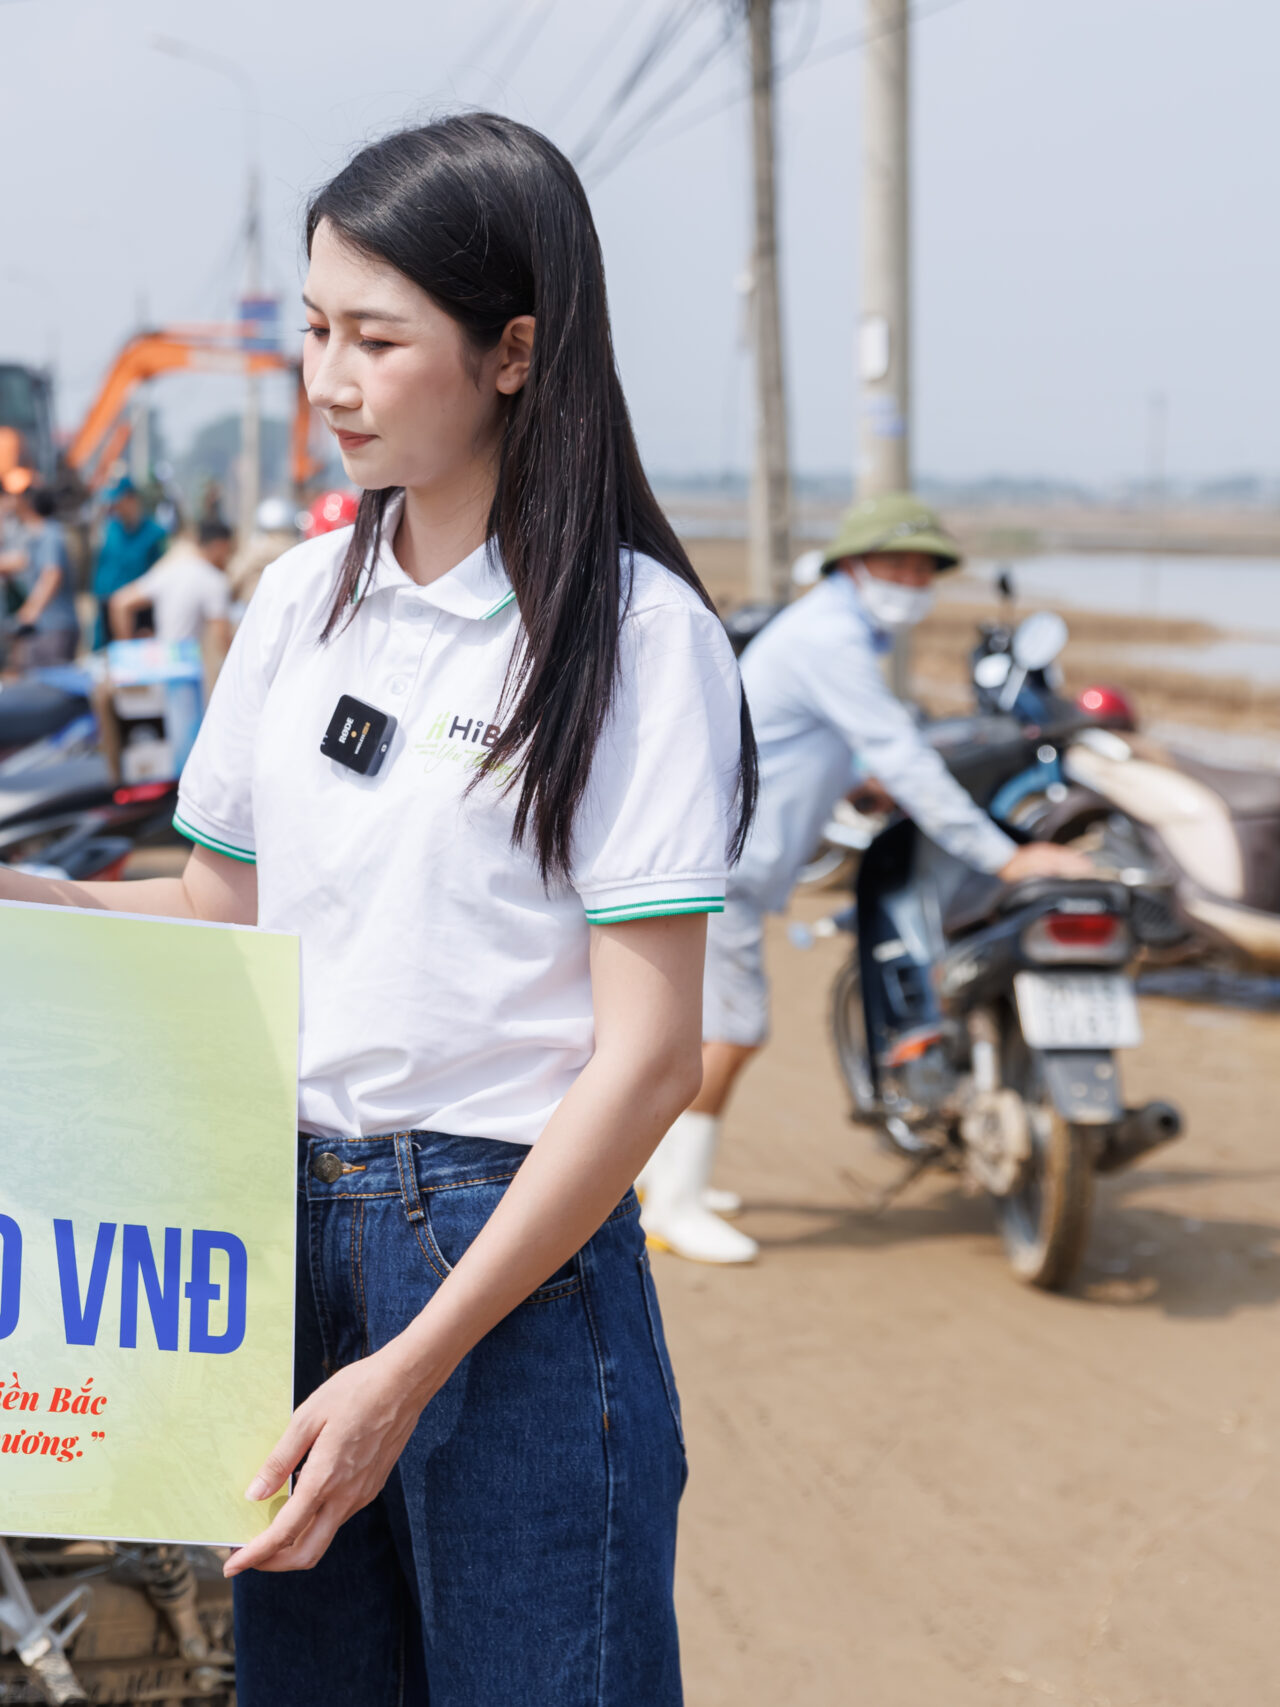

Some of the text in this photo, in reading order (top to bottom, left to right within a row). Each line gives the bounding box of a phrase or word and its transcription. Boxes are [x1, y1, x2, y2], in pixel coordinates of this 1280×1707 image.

[448, 715, 501, 748] HiB
[53, 1218, 248, 1354] VNĐ
[48, 1377, 108, 1416] Bắc
